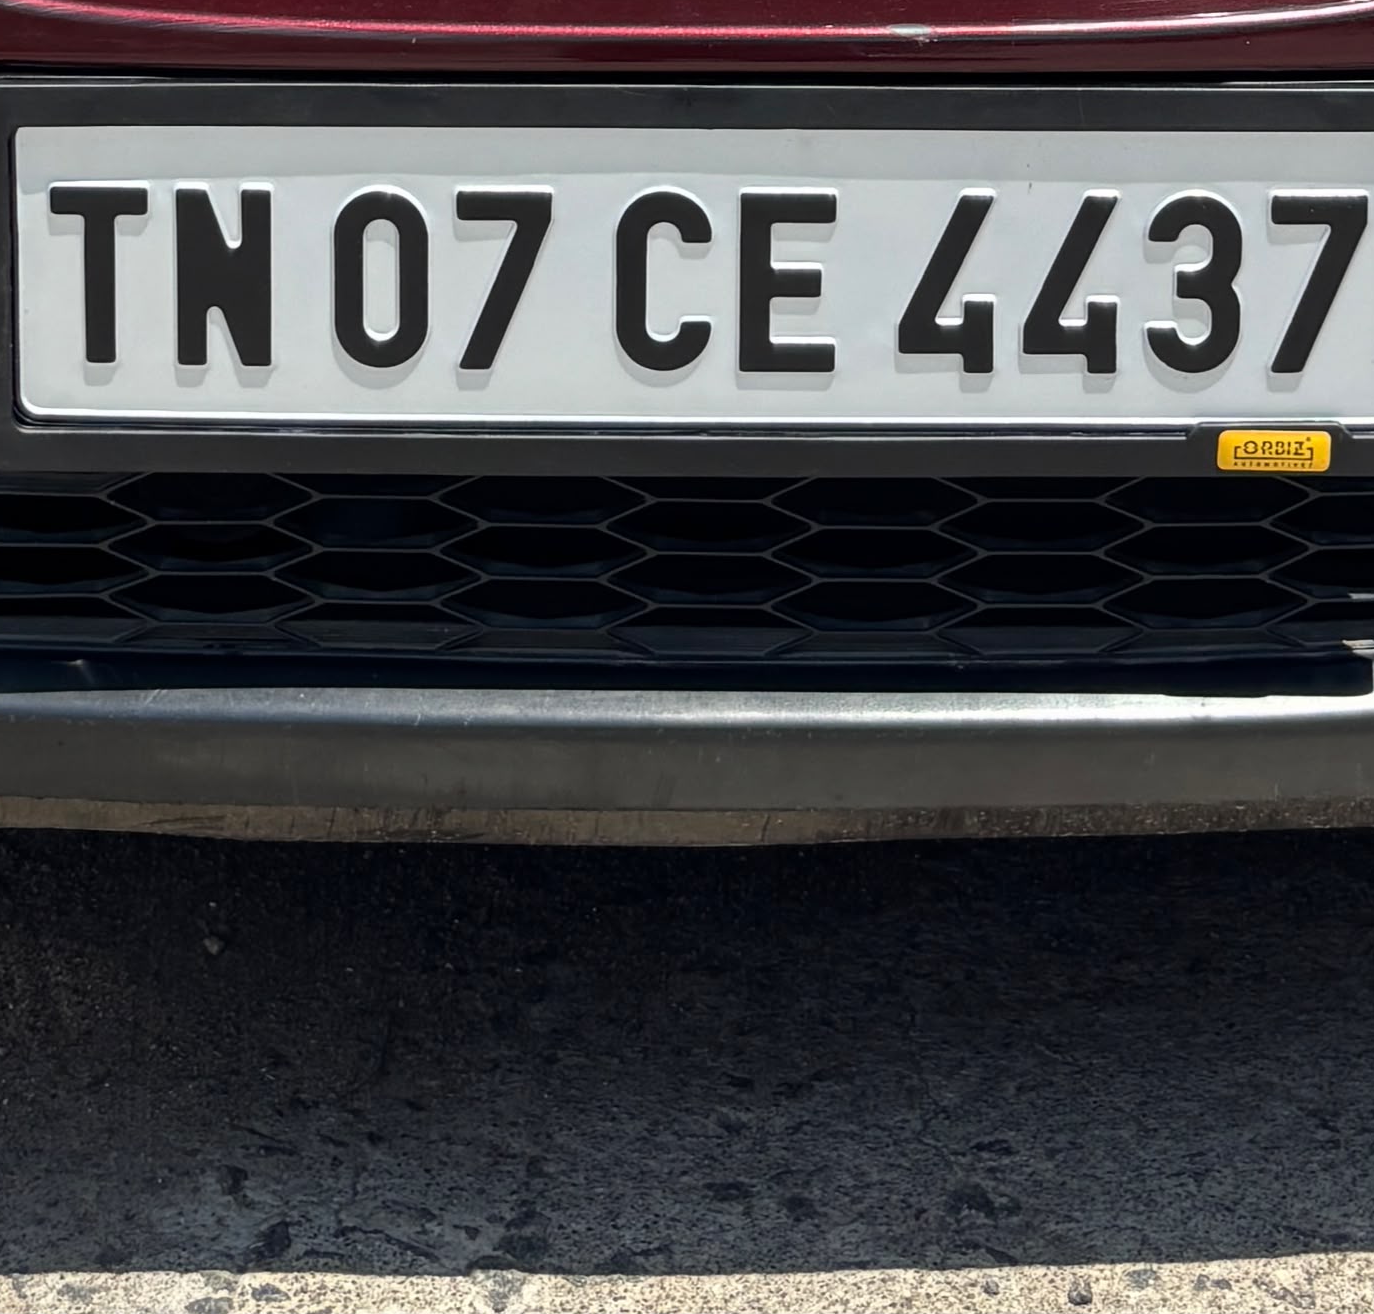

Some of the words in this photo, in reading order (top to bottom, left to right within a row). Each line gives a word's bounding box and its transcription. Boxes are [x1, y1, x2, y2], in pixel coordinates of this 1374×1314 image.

[49, 185, 272, 368] TN
[333, 191, 553, 371] 07
[615, 191, 838, 374] CE
[897, 195, 1369, 376] 4437
